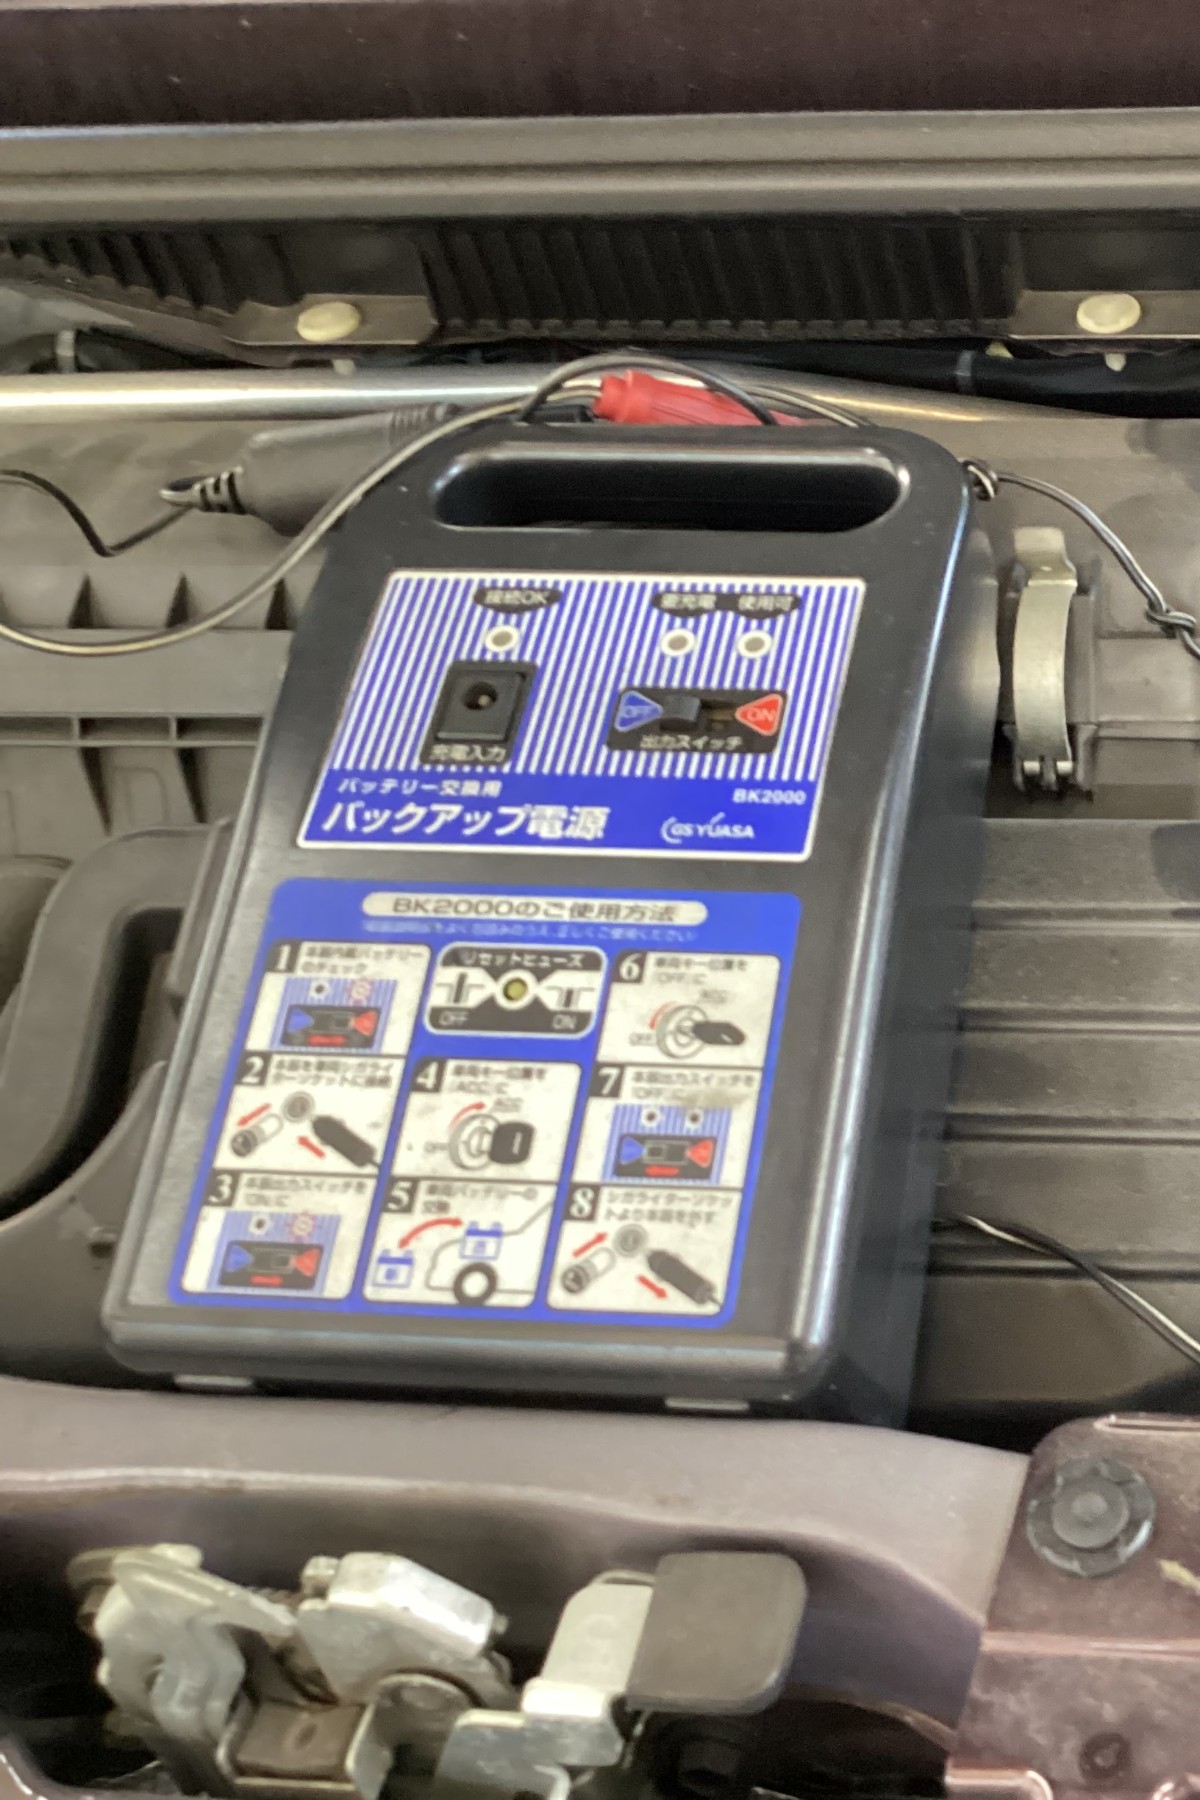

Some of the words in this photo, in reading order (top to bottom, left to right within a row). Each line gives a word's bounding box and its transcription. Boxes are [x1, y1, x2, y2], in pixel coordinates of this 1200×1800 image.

[746, 707, 776, 722] ON
[429, 744, 507, 763] 充電入力
[639, 734, 743, 750] 出力スイッチ
[337, 777, 502, 798] バッテリー交換用
[732, 788, 807, 806] BK2000
[321, 800, 611, 841] バックアップ電源
[392, 897, 679, 924] BK2000のご使用方法
[276, 943, 292, 971] 1
[619, 952, 643, 981] 6
[439, 1010, 468, 1026] OFF
[552, 1014, 577, 1031] ON
[241, 1056, 264, 1084] 2
[416, 1061, 438, 1089] 4
[598, 1067, 620, 1096] 7
[207, 1174, 233, 1203] 3
[386, 1180, 412, 1211] 5
[569, 1186, 595, 1219] 8
